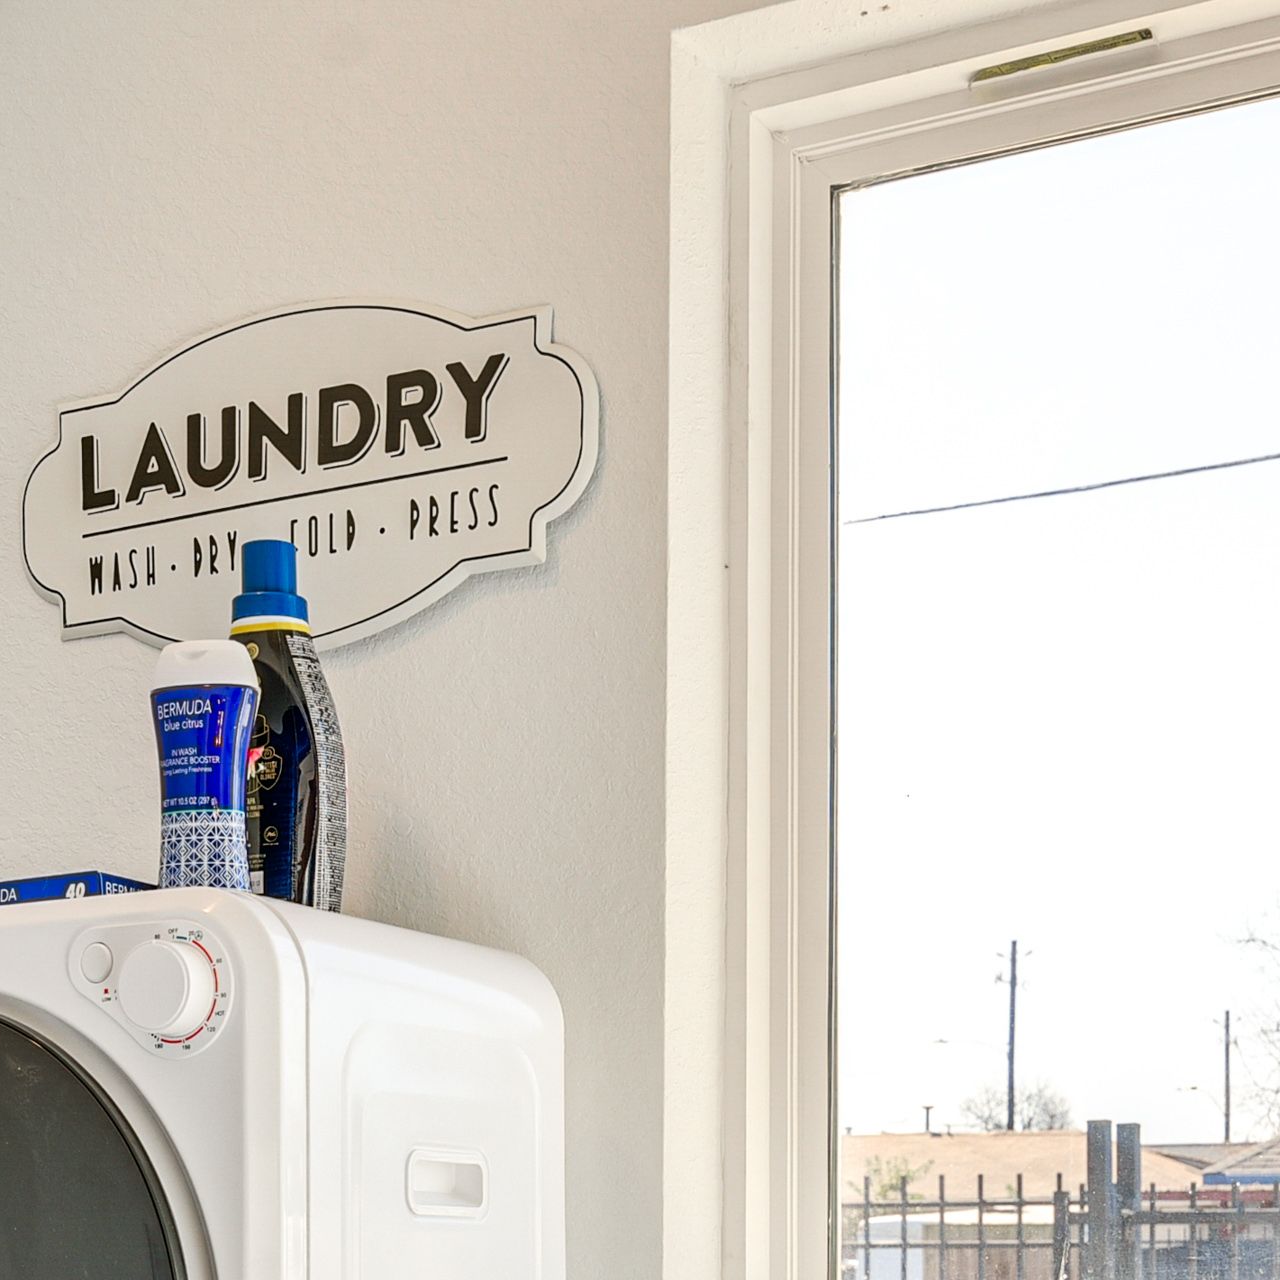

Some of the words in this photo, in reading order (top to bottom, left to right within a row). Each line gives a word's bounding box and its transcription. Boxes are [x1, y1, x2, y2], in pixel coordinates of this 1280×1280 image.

[81, 353, 510, 515] LAUNDRY
[89, 546, 156, 595] WASH
[193, 530, 237, 577] DRY
[410, 484, 499, 540] PRESS
[157, 699, 212, 720] BERMUDA
[164, 719, 180, 731] blue
[181, 717, 204, 729] citrus
[178, 746, 197, 756] WASH
[189, 755, 221, 765] BOOSTER
[65, 882, 86, 899] 40
